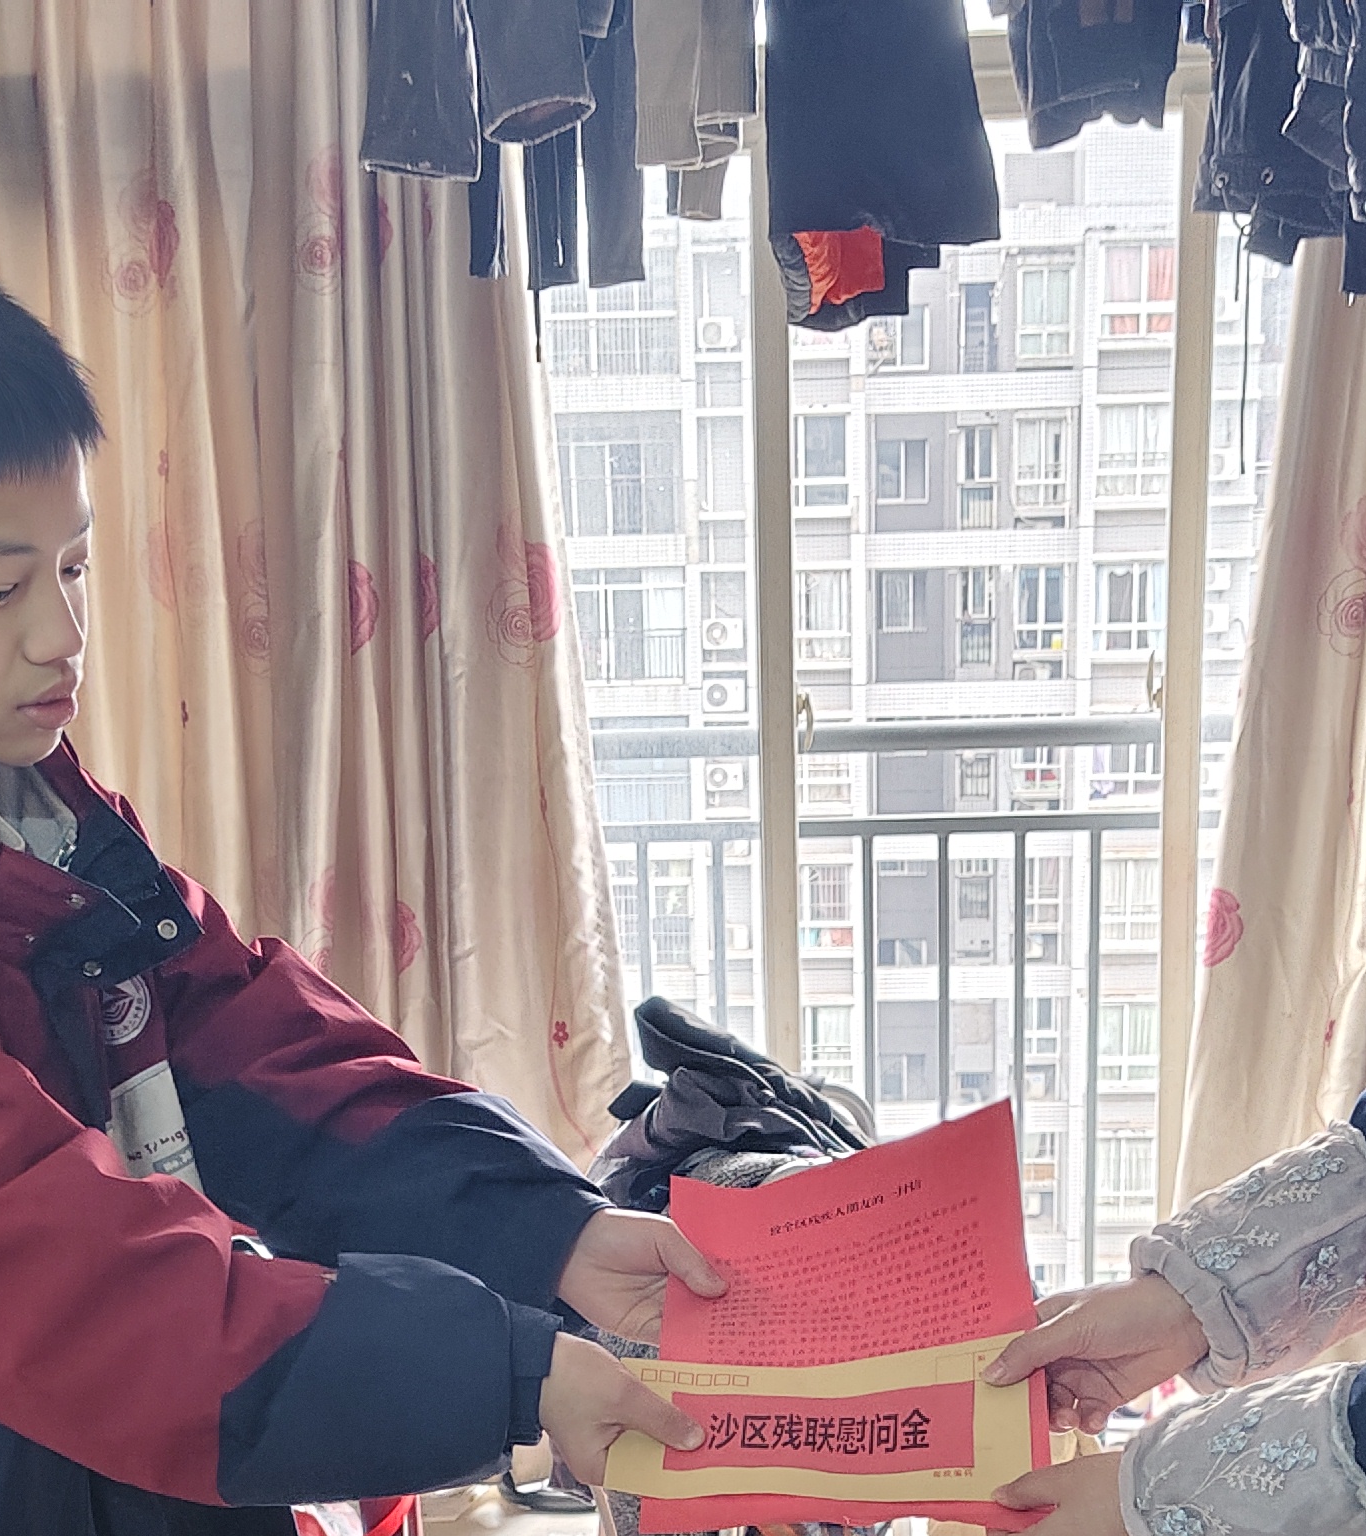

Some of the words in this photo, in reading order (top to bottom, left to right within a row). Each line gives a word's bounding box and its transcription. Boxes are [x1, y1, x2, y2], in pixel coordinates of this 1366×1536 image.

[708, 1408, 931, 1455] 沙区残联慰问金
